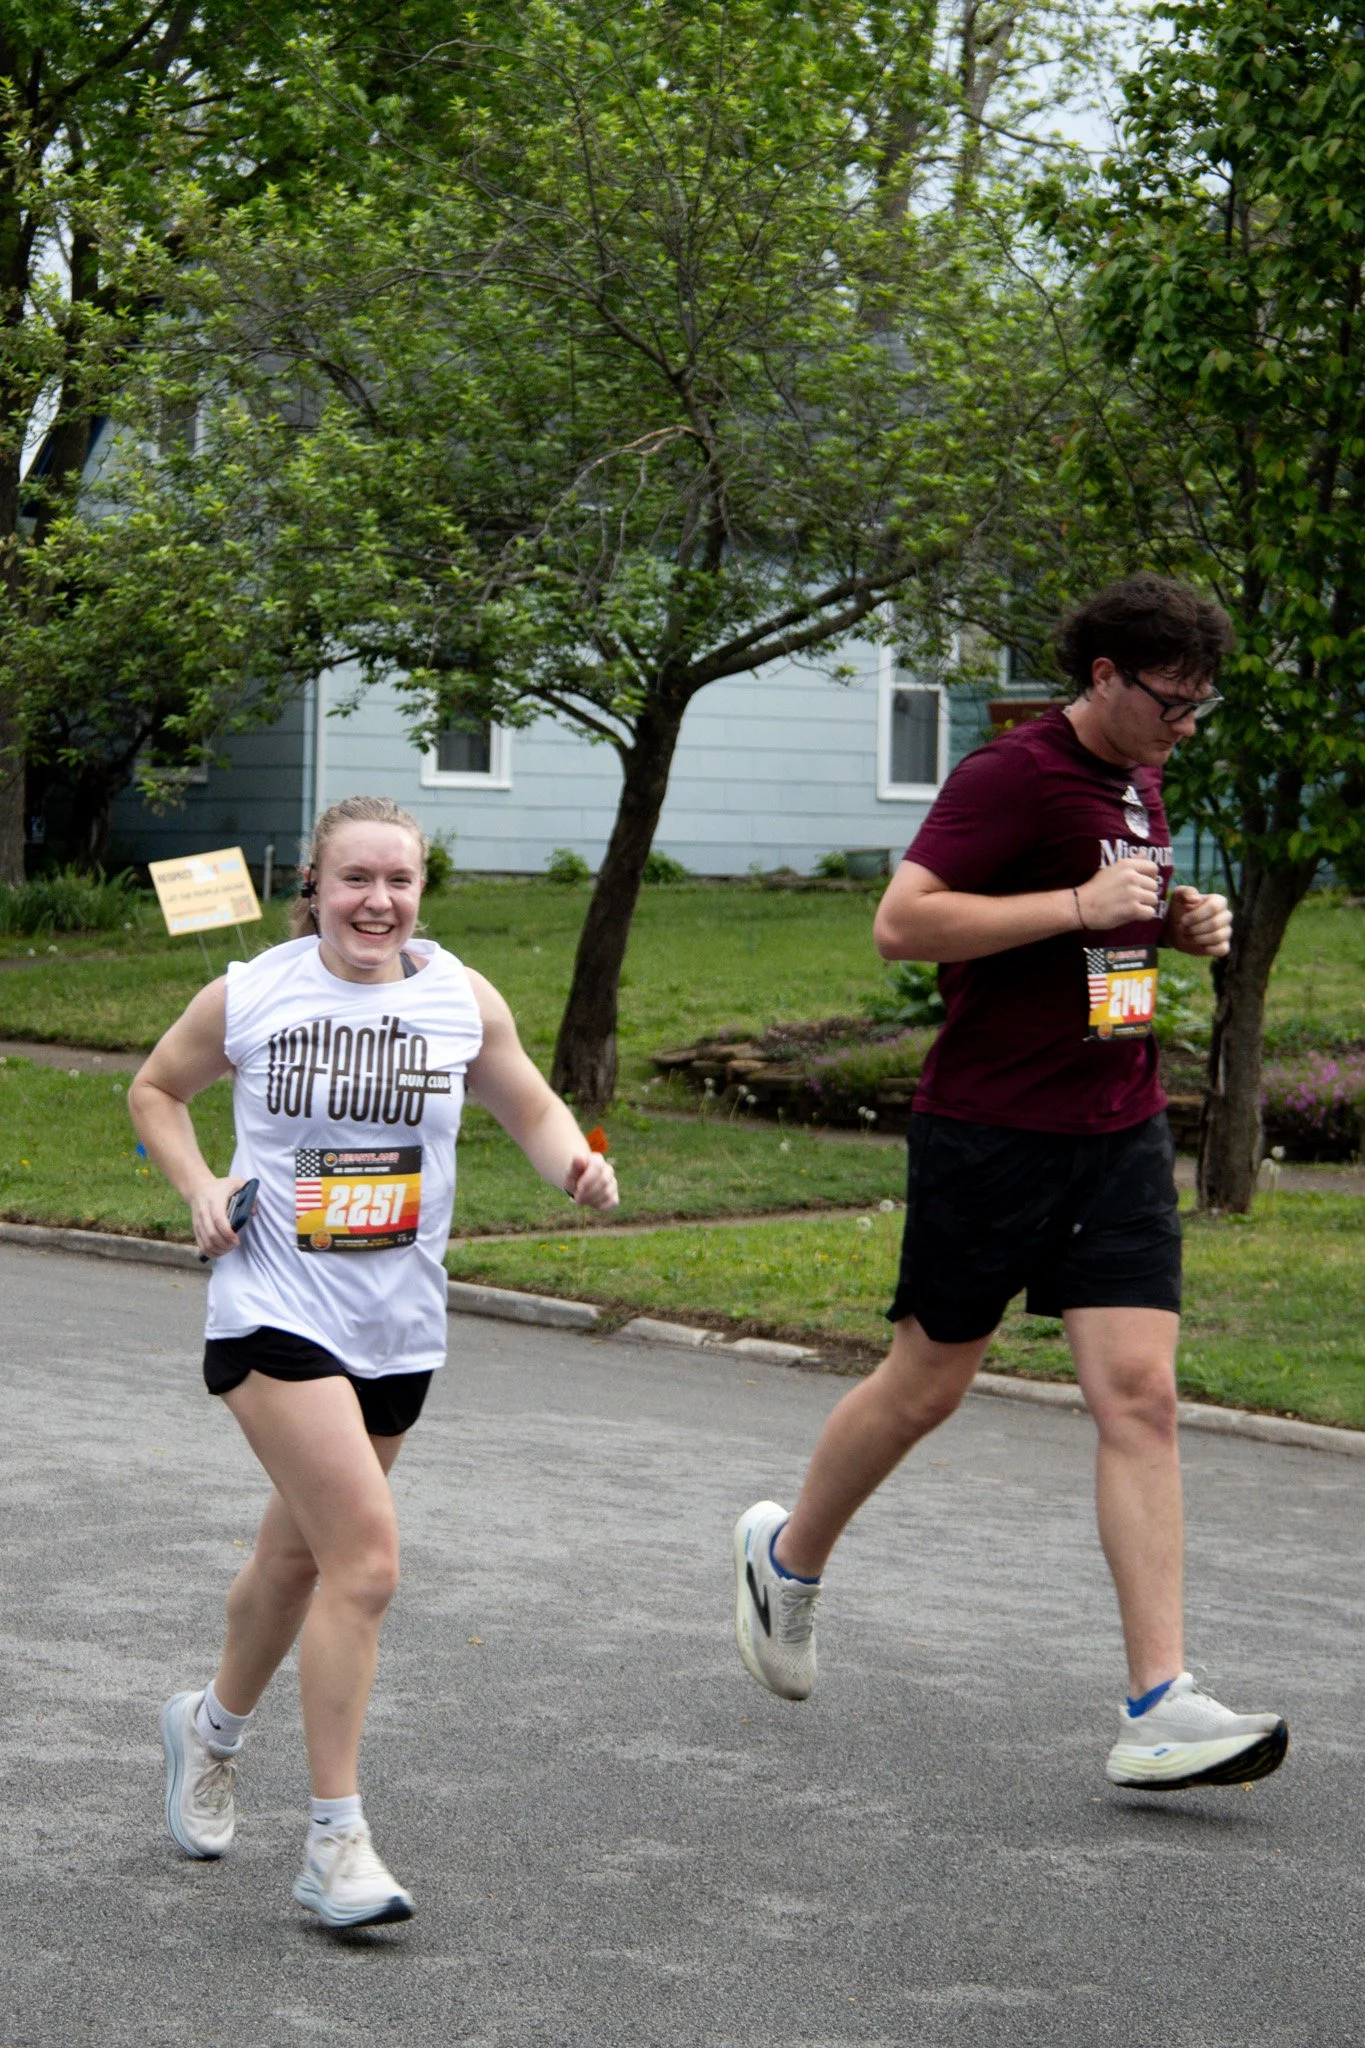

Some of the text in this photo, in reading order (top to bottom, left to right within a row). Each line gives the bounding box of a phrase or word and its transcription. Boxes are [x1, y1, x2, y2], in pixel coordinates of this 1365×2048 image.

[1108, 976, 1153, 1018] 2146
[398, 1073, 451, 1089] RUN CLUB
[324, 1182, 408, 1228] 2251
